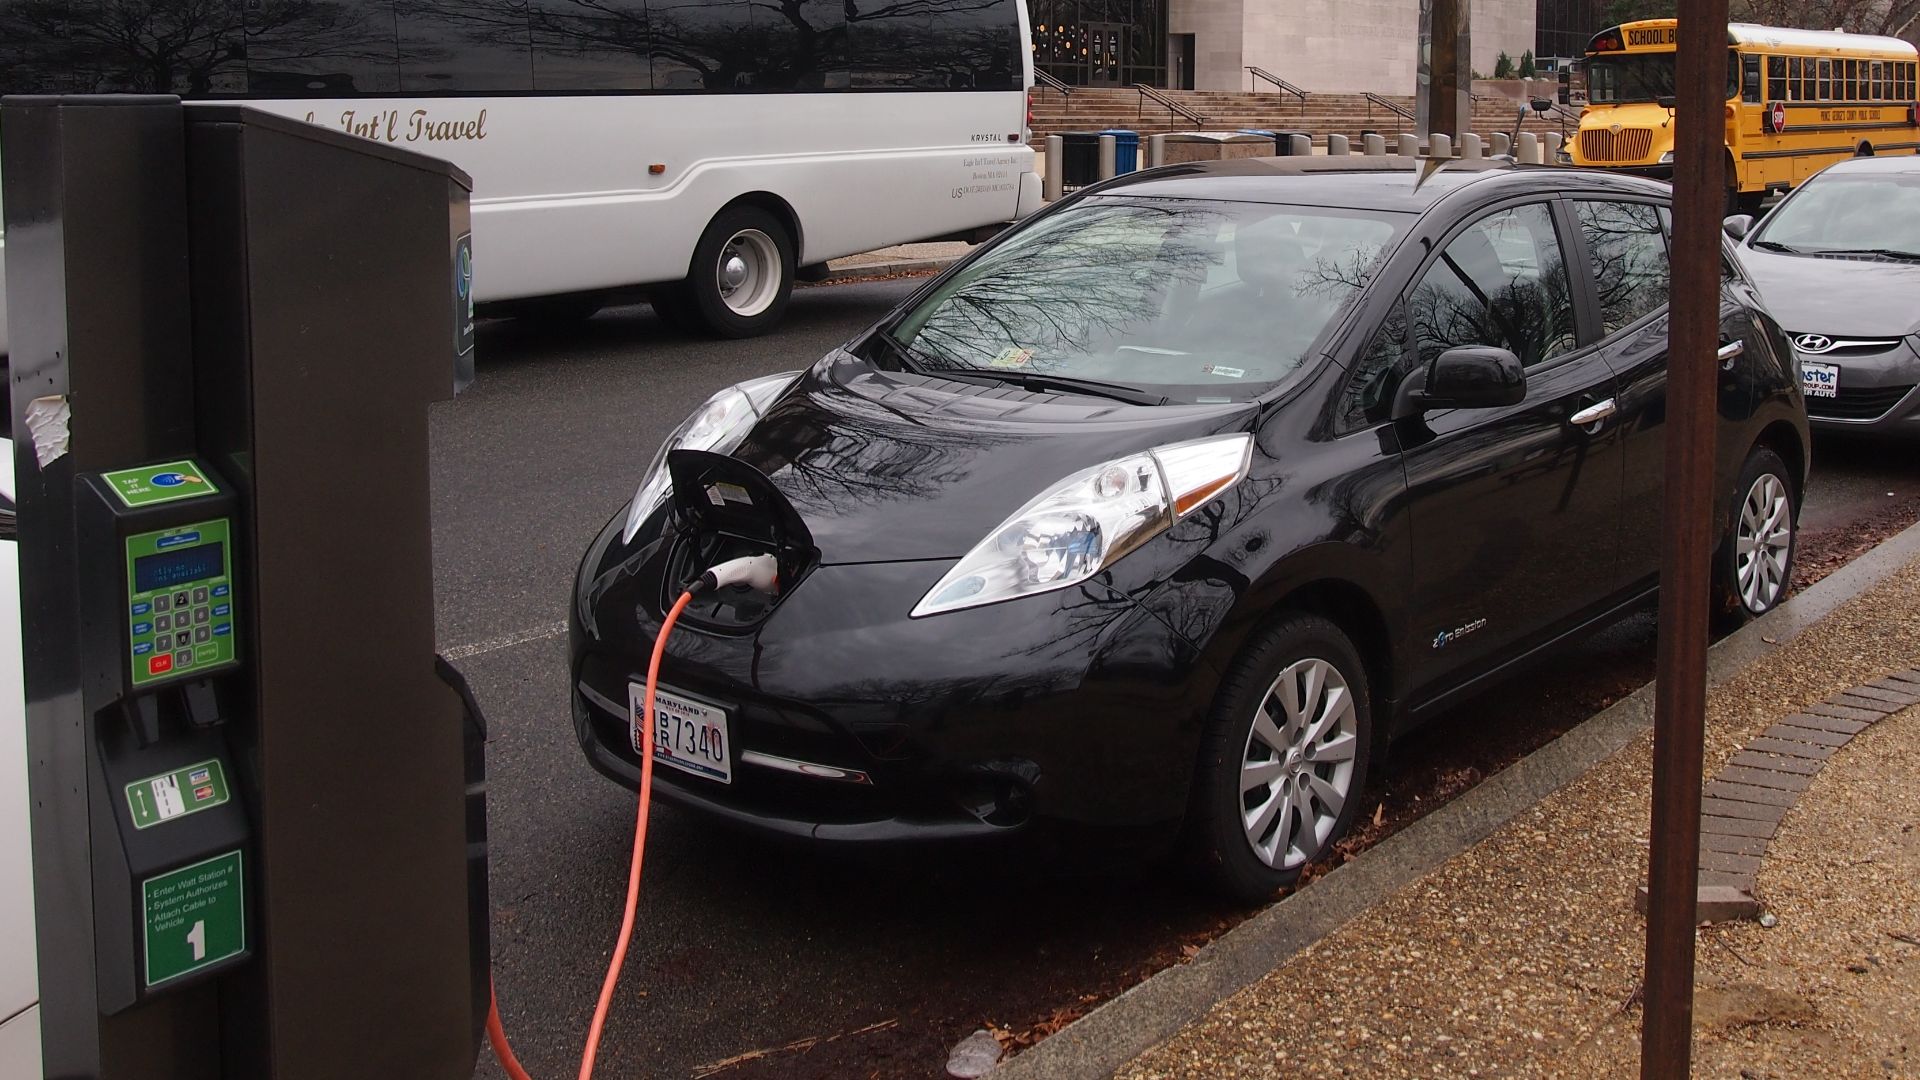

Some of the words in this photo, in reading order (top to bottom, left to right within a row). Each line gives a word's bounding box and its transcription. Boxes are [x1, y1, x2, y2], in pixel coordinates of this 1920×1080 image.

[1628, 29, 1664, 45] SCHOOL
[406, 109, 487, 141] Travel
[970, 134, 1002, 142] KRYSTAL
[1813, 390, 1836, 398] AUTO
[126, 487, 151, 495] HERE
[655, 696, 700, 716] MARYLAND
[153, 885, 176, 898] Enter
[177, 878, 197, 889] Watt
[198, 868, 226, 883] Station
[153, 894, 185, 911] System
[186, 880, 228, 899] Authorizes
[154, 908, 181, 923] Attach
[182, 898, 207, 913] Cable
[208, 896, 217, 905] to
[154, 917, 185, 932] Vehicle
[187, 919, 206, 961] 1
